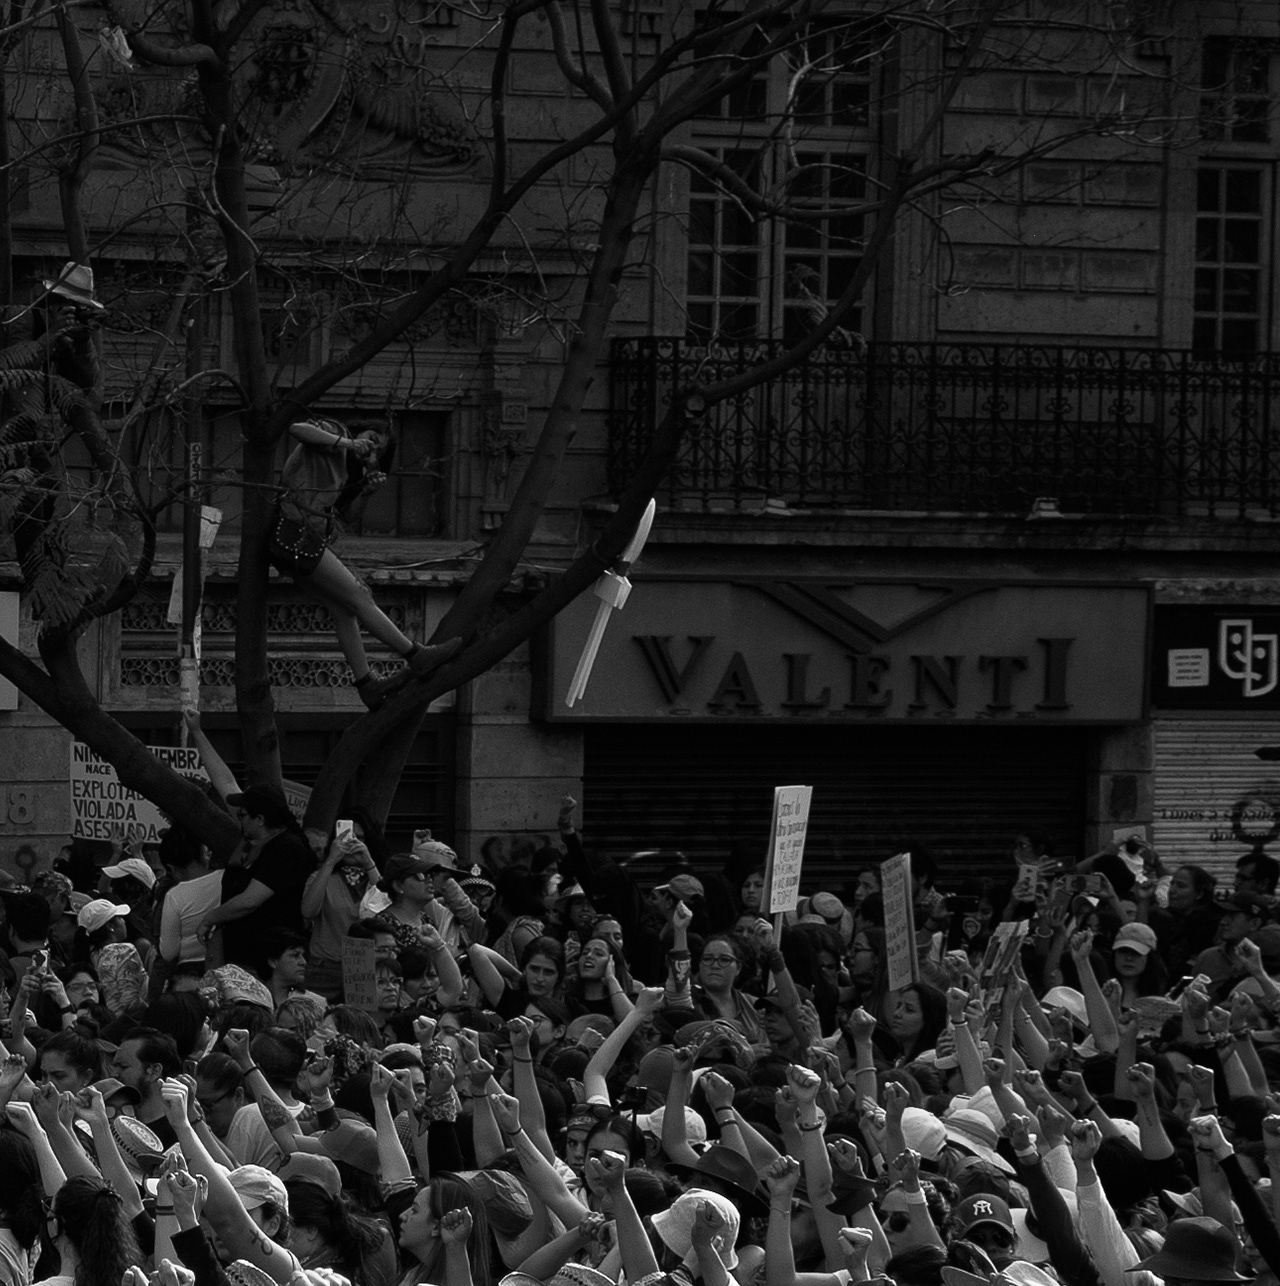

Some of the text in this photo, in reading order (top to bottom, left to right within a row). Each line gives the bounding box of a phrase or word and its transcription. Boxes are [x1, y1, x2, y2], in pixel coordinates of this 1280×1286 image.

[633, 634, 1077, 711] VALENTI
[86, 764, 111, 776] NACE
[73, 799, 137, 821] VIOLADA
